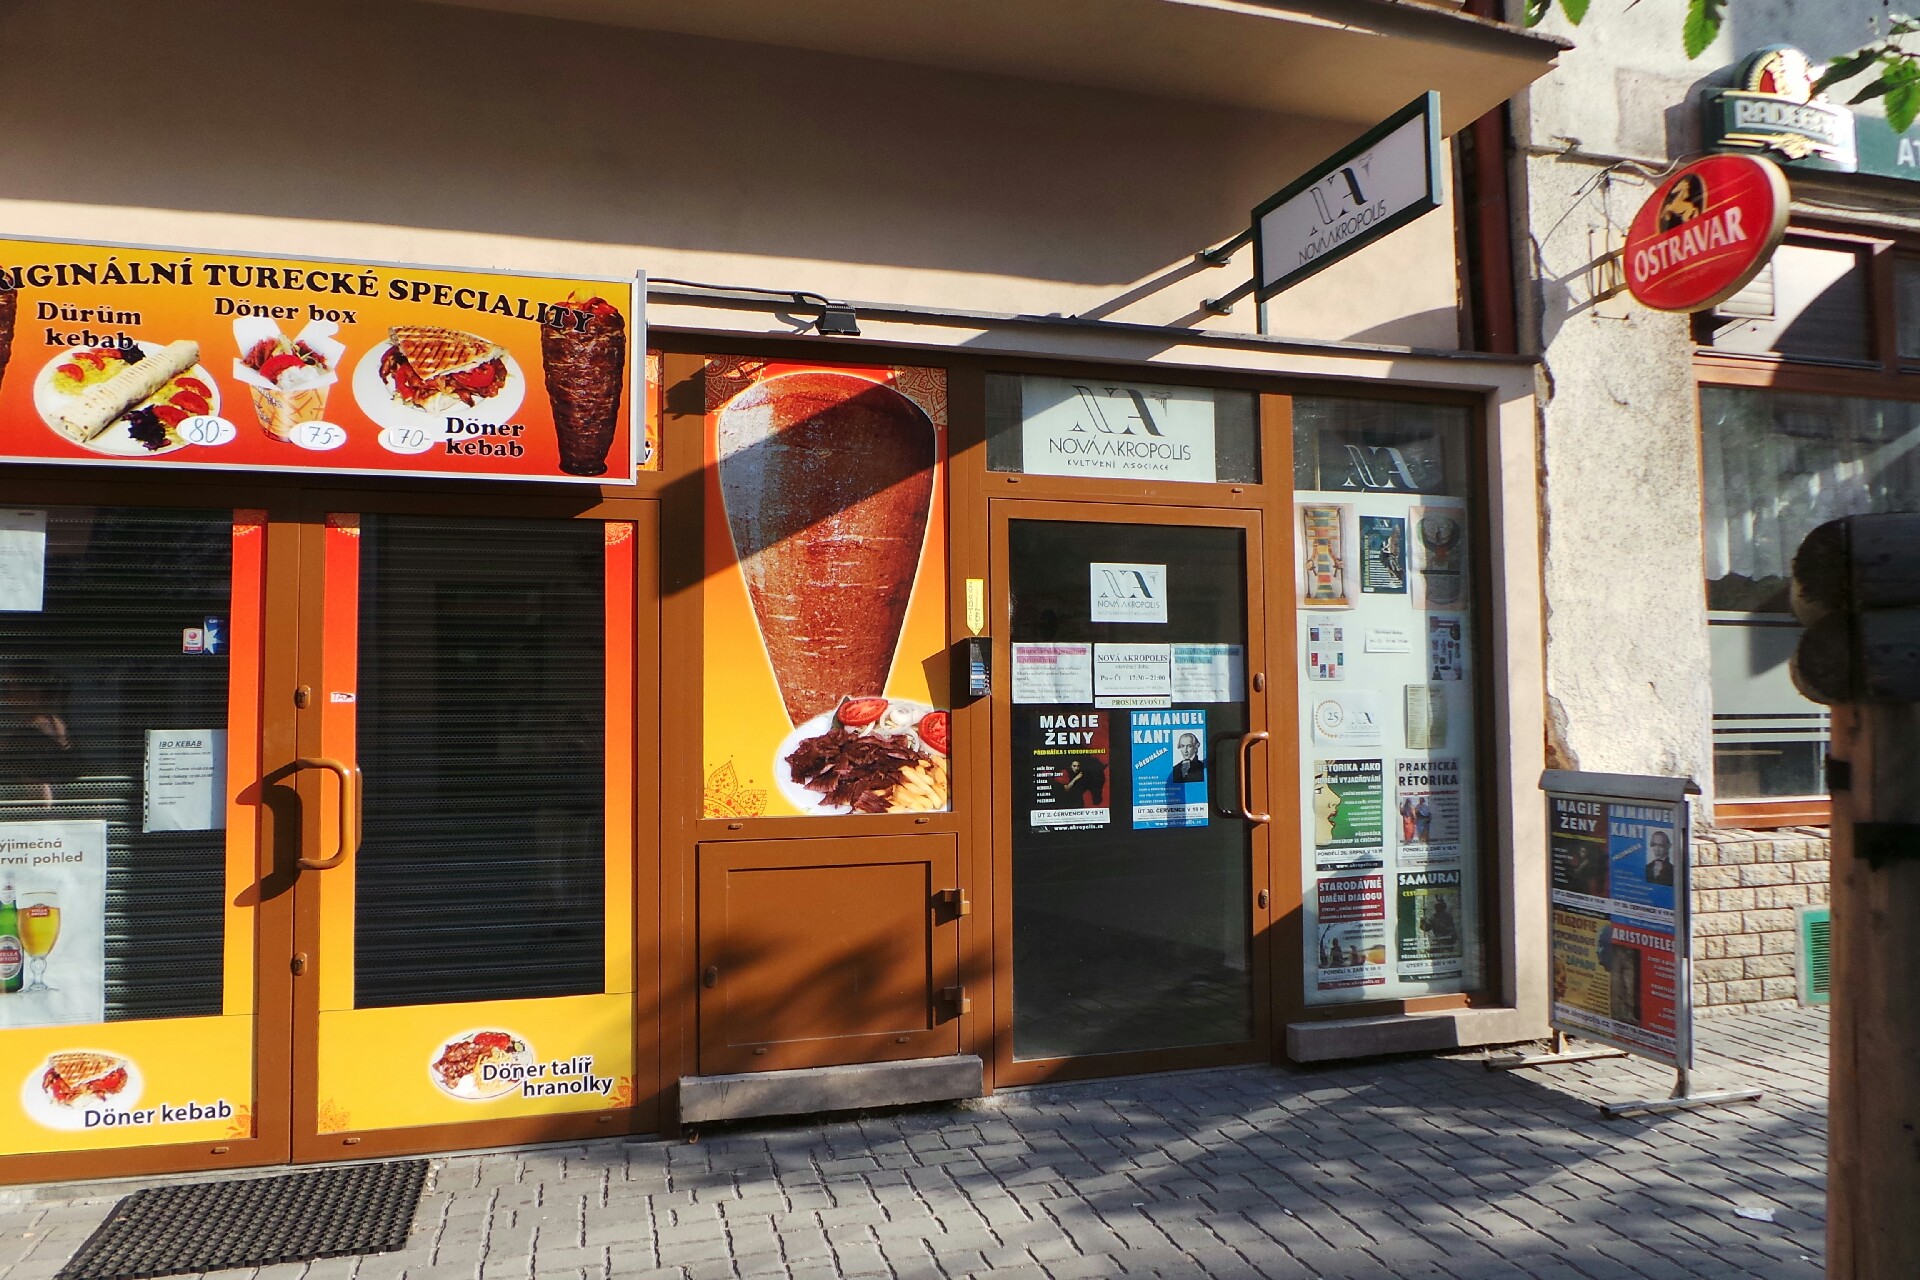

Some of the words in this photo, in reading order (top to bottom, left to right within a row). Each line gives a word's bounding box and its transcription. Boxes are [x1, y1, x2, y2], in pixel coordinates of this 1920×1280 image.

[1634, 205, 1748, 283] OSTRAVAR
[203, 264, 379, 297] TURECKÉ
[388, 279, 595, 333] SPECIALITY
[37, 302, 142, 326] Dürüm
[215, 297, 299, 320] Döner
[309, 303, 357, 325] box
[45, 327, 135, 349] kebab
[445, 417, 525, 437] Döner
[445, 438, 524, 458] kebab
[1049, 435, 1100, 454] NOVÁ
[1102, 439, 1192, 461] AKROPOLIS
[1122, 462, 1169, 471] ASOCIACE
[1097, 599, 1119, 609] NOVÁ
[1121, 601, 1161, 610] AKROPOLIS
[1097, 653, 1121, 662] NOVÁ
[1122, 654, 1168, 662] AKROPOLIS
[1112, 698, 1138, 706] PROSÍM
[1040, 714, 1099, 729] MAGIE
[1132, 712, 1204, 726] IMMANUEL
[1327, 711, 1339, 722] 25
[175, 740, 202, 748] KEBAB
[1045, 729, 1094, 746] ŽENY
[1133, 729, 1171, 744] KANT
[1134, 747, 1169, 770] PŘEDNÁŠKA
[1399, 759, 1457, 772] PRAKTICKÁ
[1359, 762, 1381, 771] JAKO
[1399, 773, 1458, 787] RÉTORIKA
[1053, 810, 1083, 818] ČERVENCE
[1556, 799, 1601, 816] MAGIE
[1560, 813, 1597, 832] ŽENY
[1609, 821, 1643, 839] KANT
[33, 851, 83, 866] pohled
[1319, 878, 1382, 892] STARODÁVNÉ
[1399, 871, 1459, 886] SAMURAJ
[1319, 893, 1346, 904] UMĚNÍ
[1348, 892, 1382, 902] DIALOGU
[482, 1063, 546, 1081] Döner
[551, 1056, 593, 1075] talíř
[522, 1076, 613, 1097] hranolky
[84, 1108, 155, 1128] Döner
[161, 1100, 232, 1123] kebab
